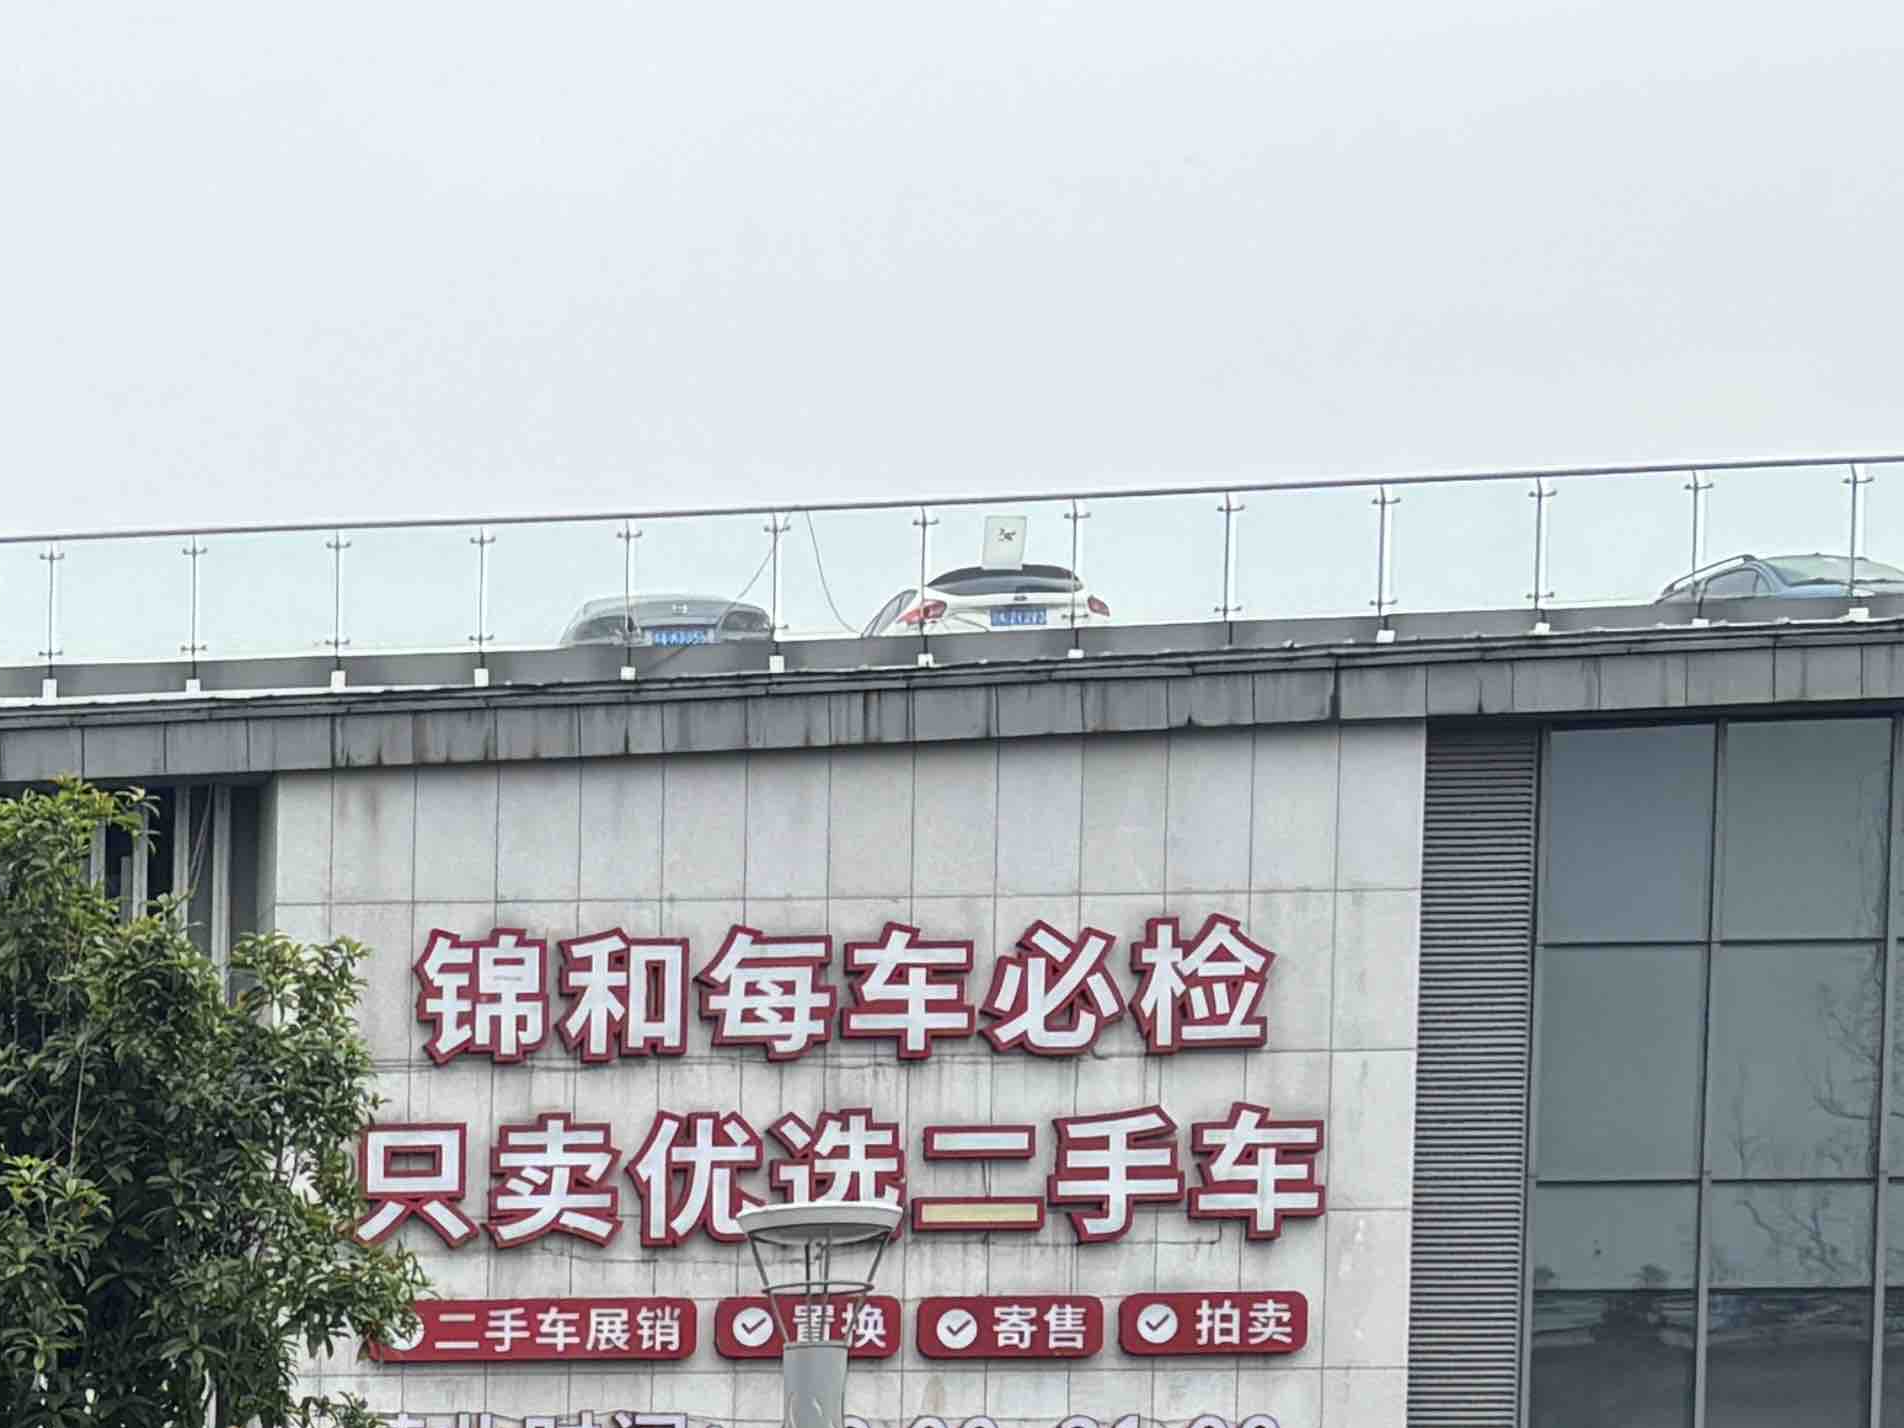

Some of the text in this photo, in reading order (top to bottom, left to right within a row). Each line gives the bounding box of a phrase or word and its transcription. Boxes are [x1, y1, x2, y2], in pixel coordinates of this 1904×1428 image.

[417, 914, 1275, 1063] 锦和每车必检
[356, 1103, 1326, 1247] 只卖优选二手车
[434, 1299, 1294, 1352] 二手车展销 置换 寄售 拍卖
